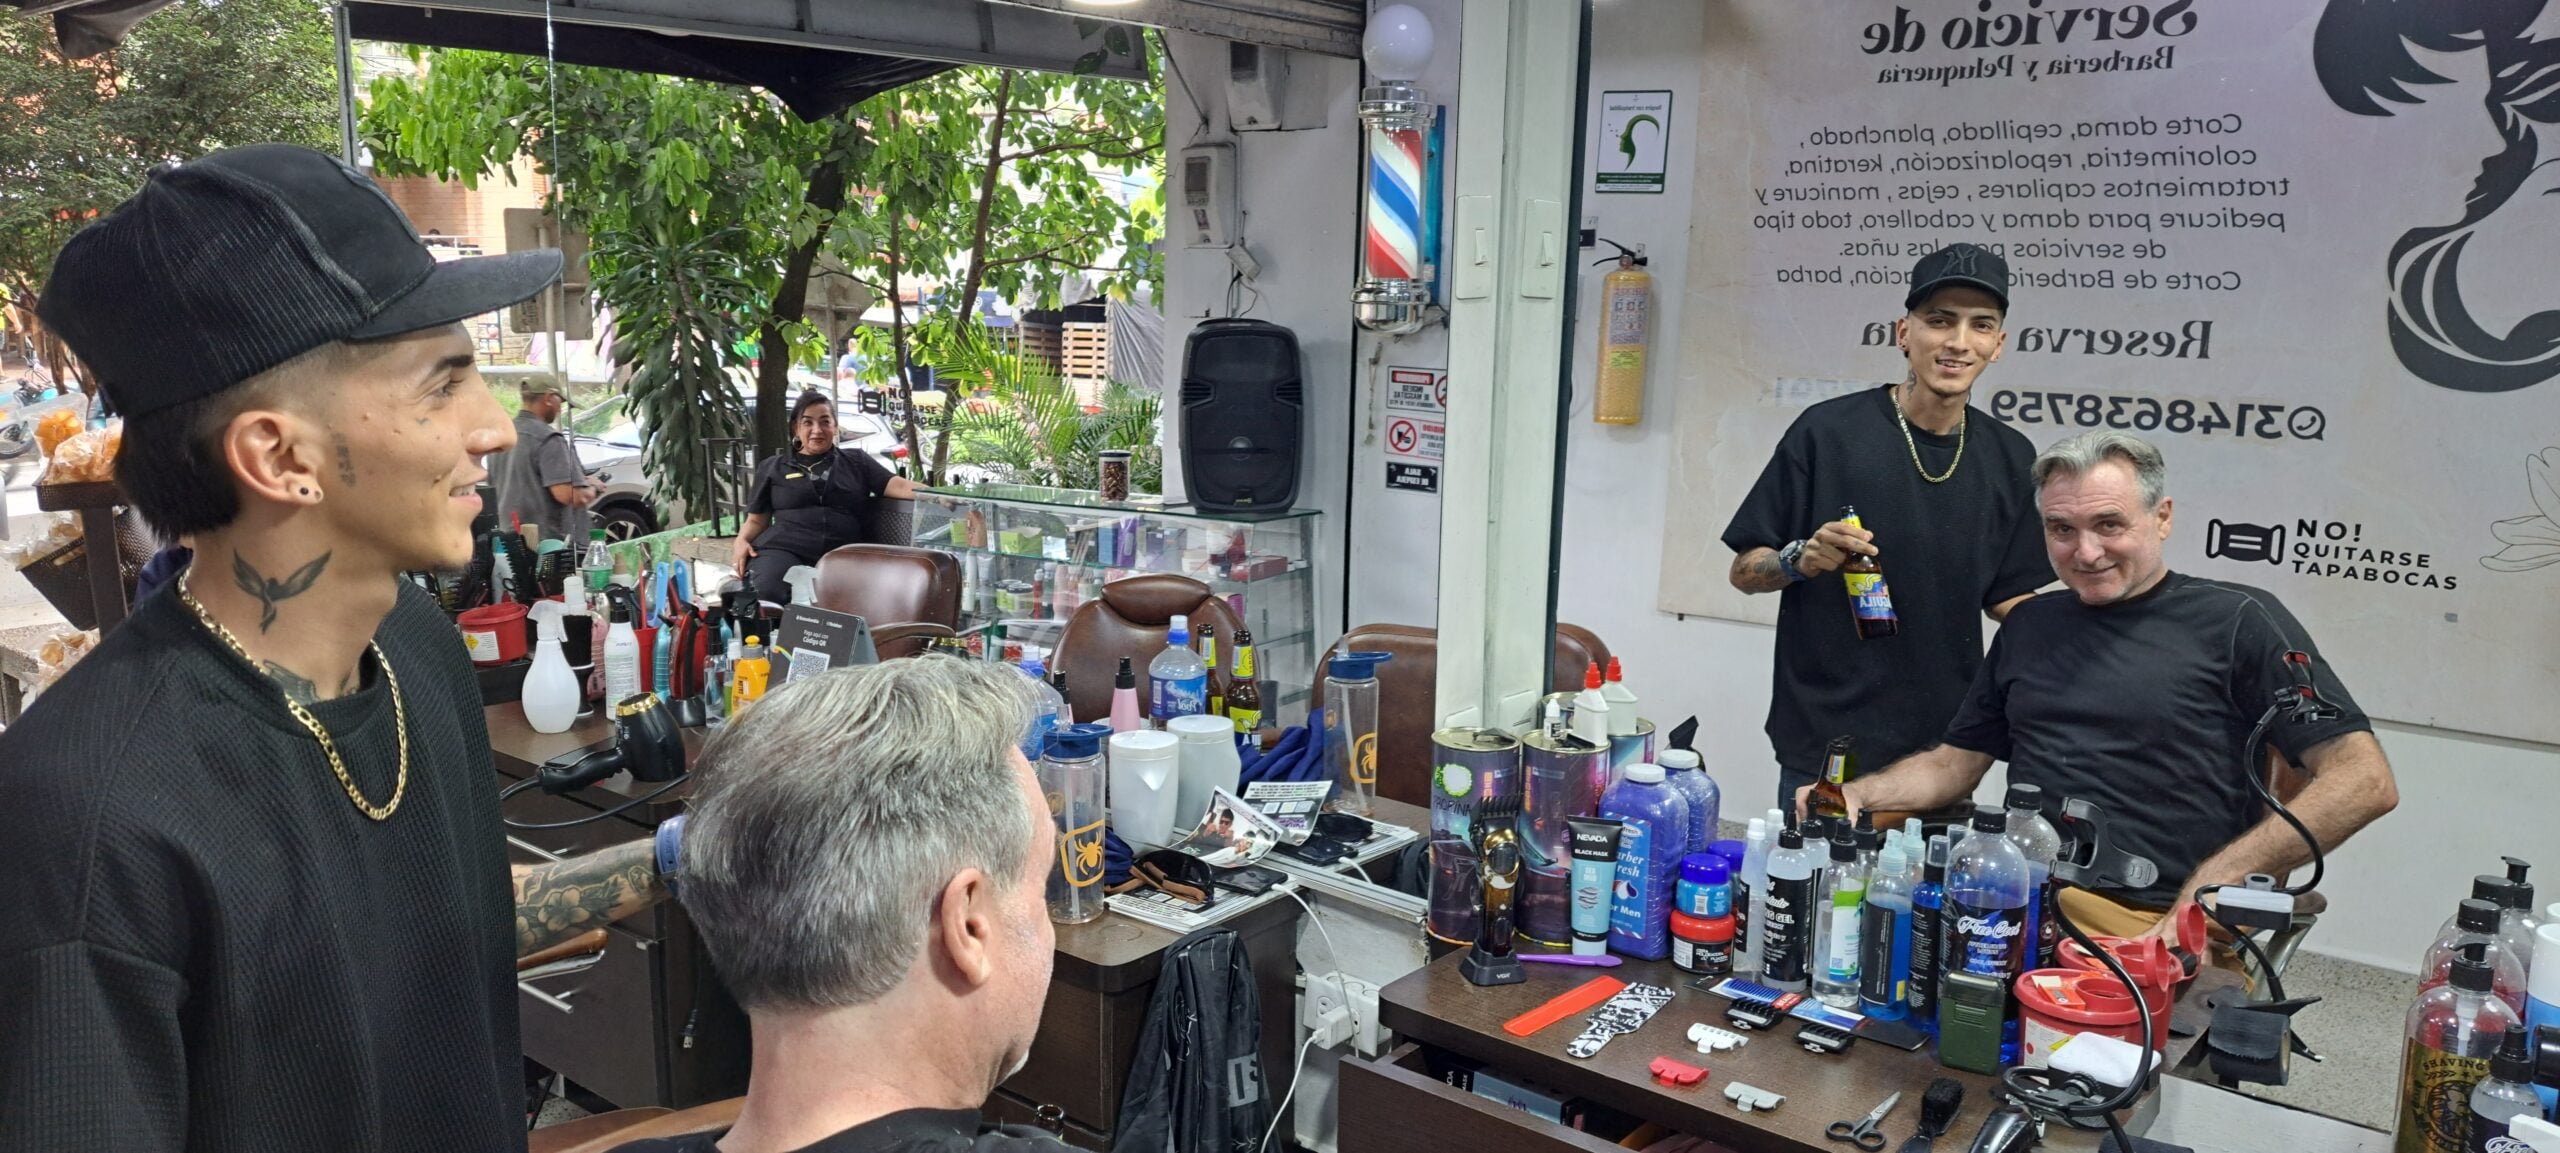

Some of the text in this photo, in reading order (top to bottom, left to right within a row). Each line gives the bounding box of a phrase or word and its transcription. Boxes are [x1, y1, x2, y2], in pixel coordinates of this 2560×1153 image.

[2296, 519, 2362, 543] NO!
[2293, 542, 2431, 568] QUITARSE
[2291, 560, 2458, 590] TAPABOCAS
[1576, 833, 1608, 843] NEVADA
[1574, 848, 1609, 857] BLACK MASK
[1616, 865, 1640, 878] resh
[1620, 904, 1641, 918] Men
[2423, 1058, 2486, 1071] SHAVING
